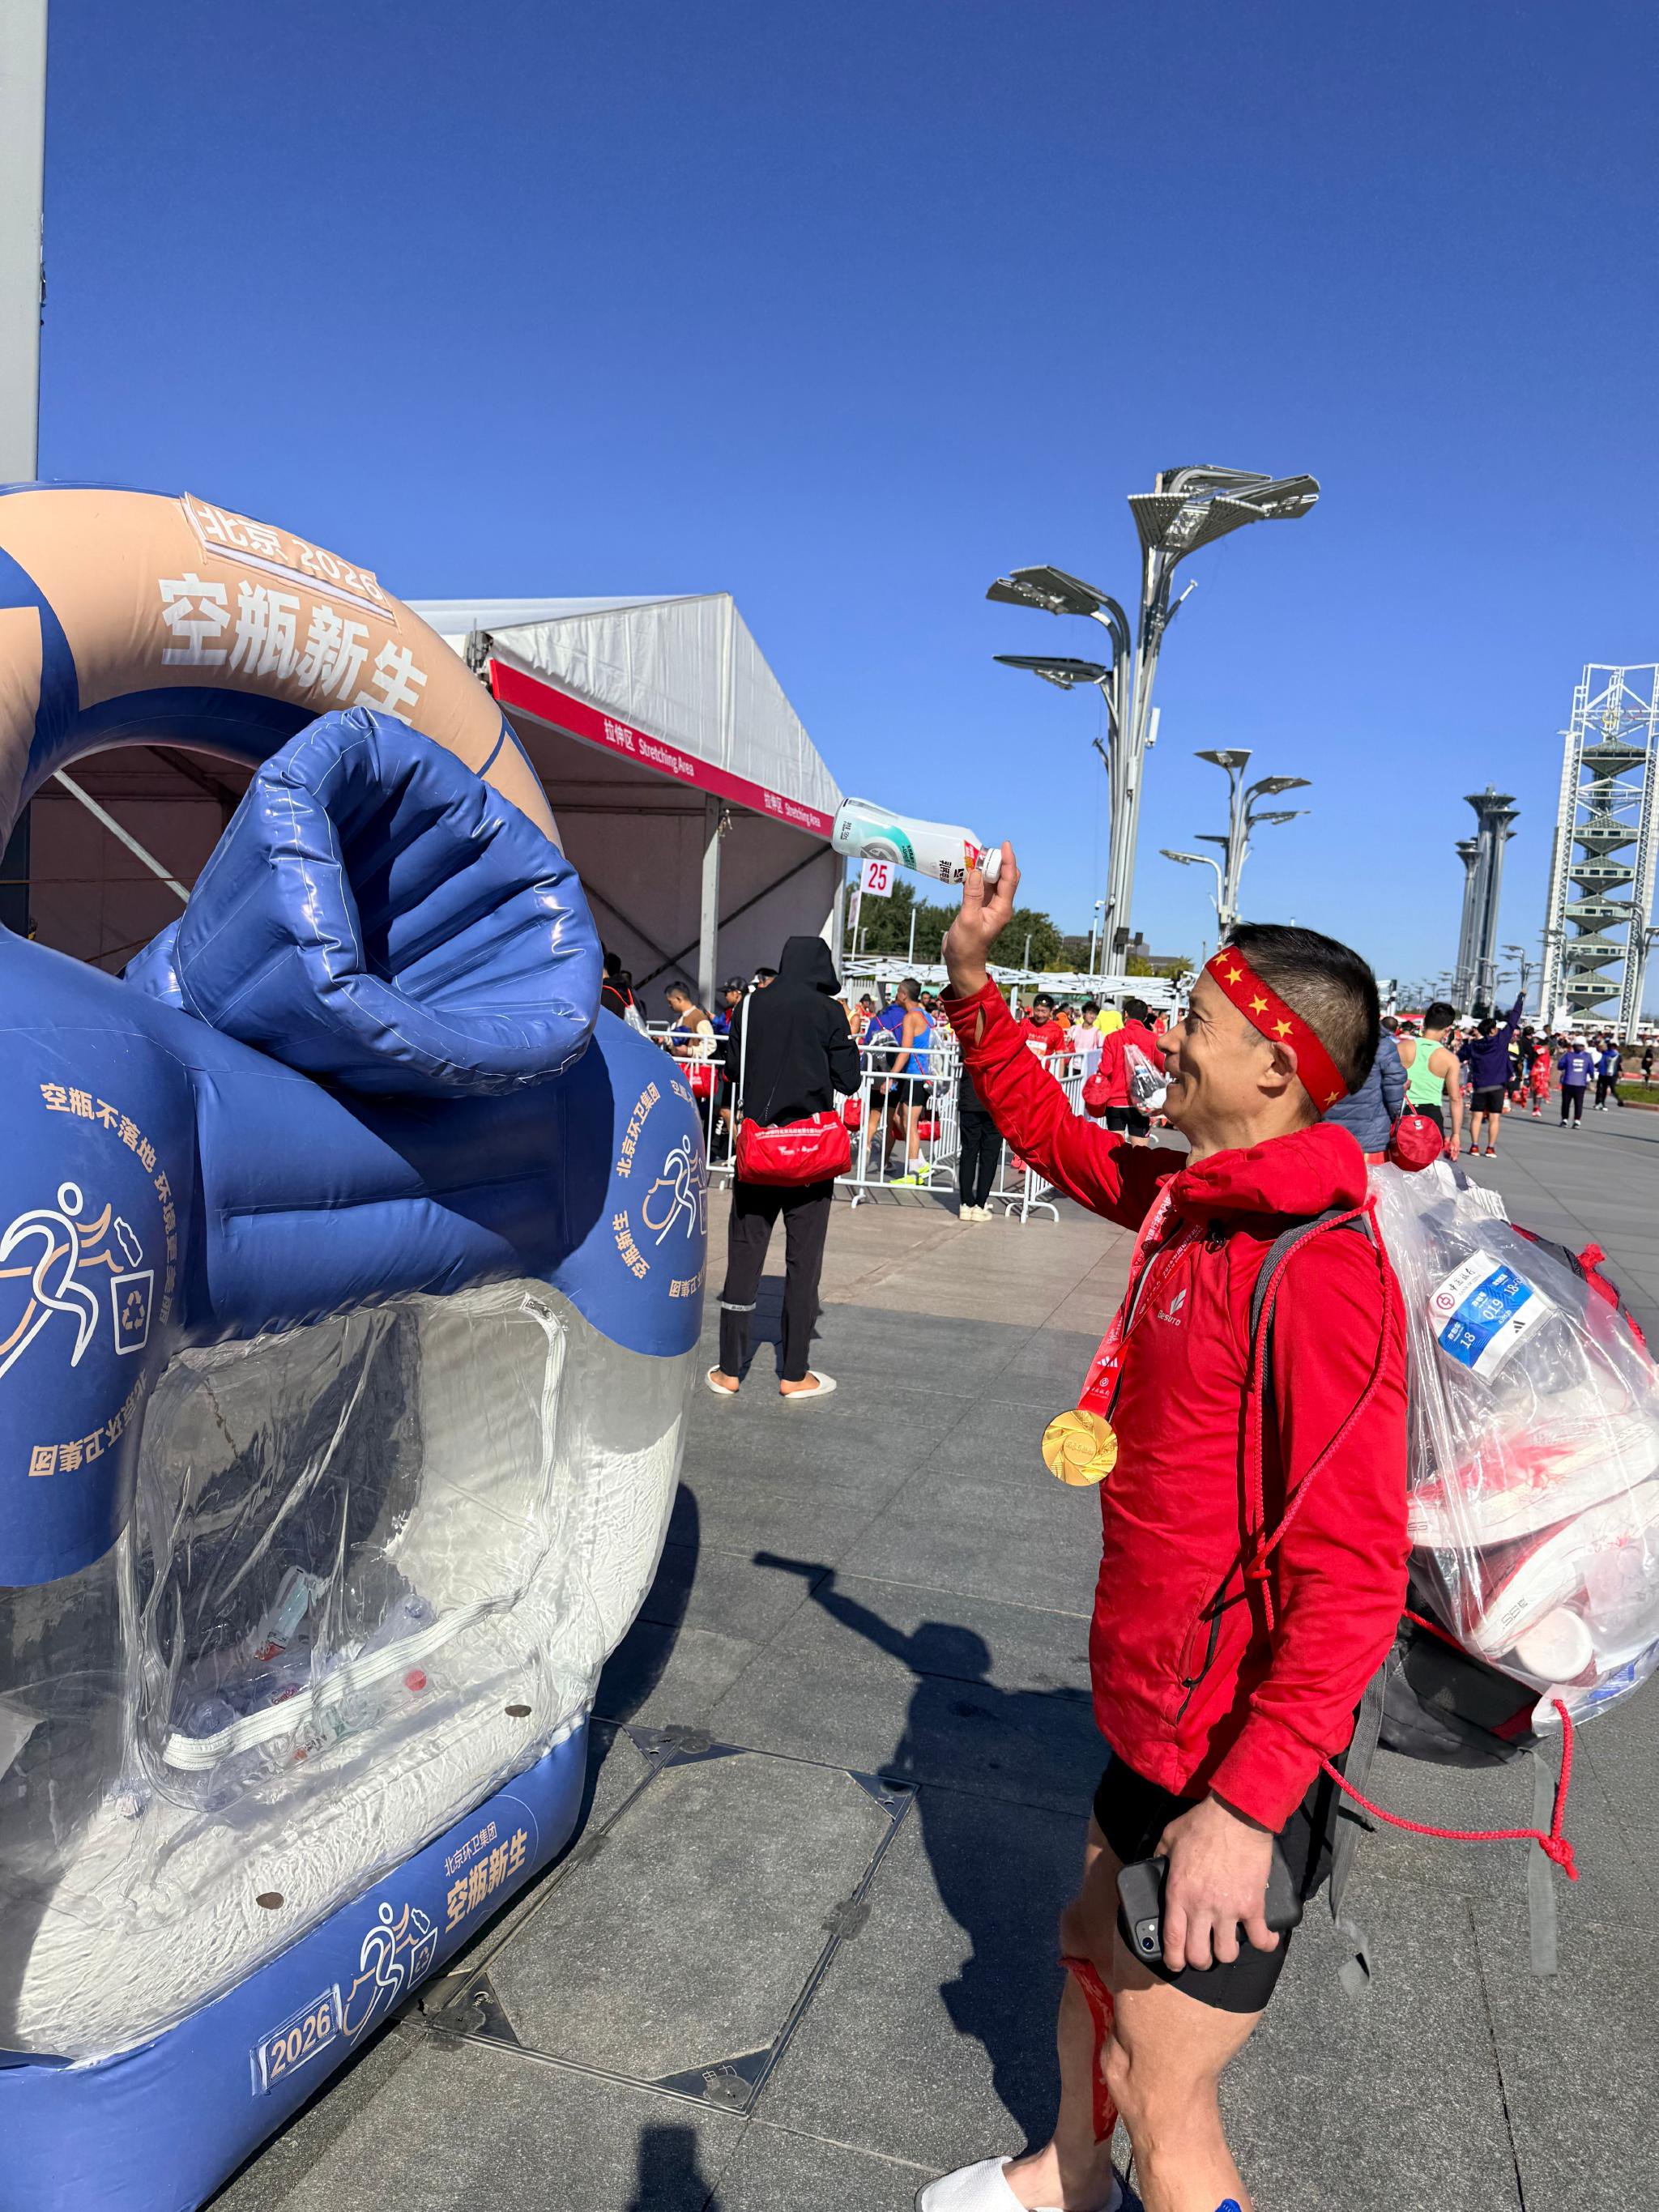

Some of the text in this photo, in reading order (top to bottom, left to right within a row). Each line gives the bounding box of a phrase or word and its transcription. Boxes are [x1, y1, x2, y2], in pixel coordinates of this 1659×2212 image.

[198, 505, 384, 600] 北京 2026
[158, 573, 428, 727] 空瓶新生
[603, 718, 695, 777] 拉伸区 Stretching Area
[763, 790, 784, 815] 拉伸区
[868, 863, 888, 891] 25
[40, 1082, 157, 1174] 空瓶不落地
[616, 1081, 661, 1178] 北京环卫集团
[612, 1209, 650, 1280] 空瓶新生
[1460, 1331, 1476, 1349] 18
[1482, 1298, 1504, 1320] 019
[28, 1367, 148, 1477] 北京环卫集团
[444, 1821, 498, 1877] 北京环卫集团
[445, 1827, 527, 1934] 空瓶新生
[270, 2003, 331, 2080] 2026
[702, 2065, 737, 2082] 电力
